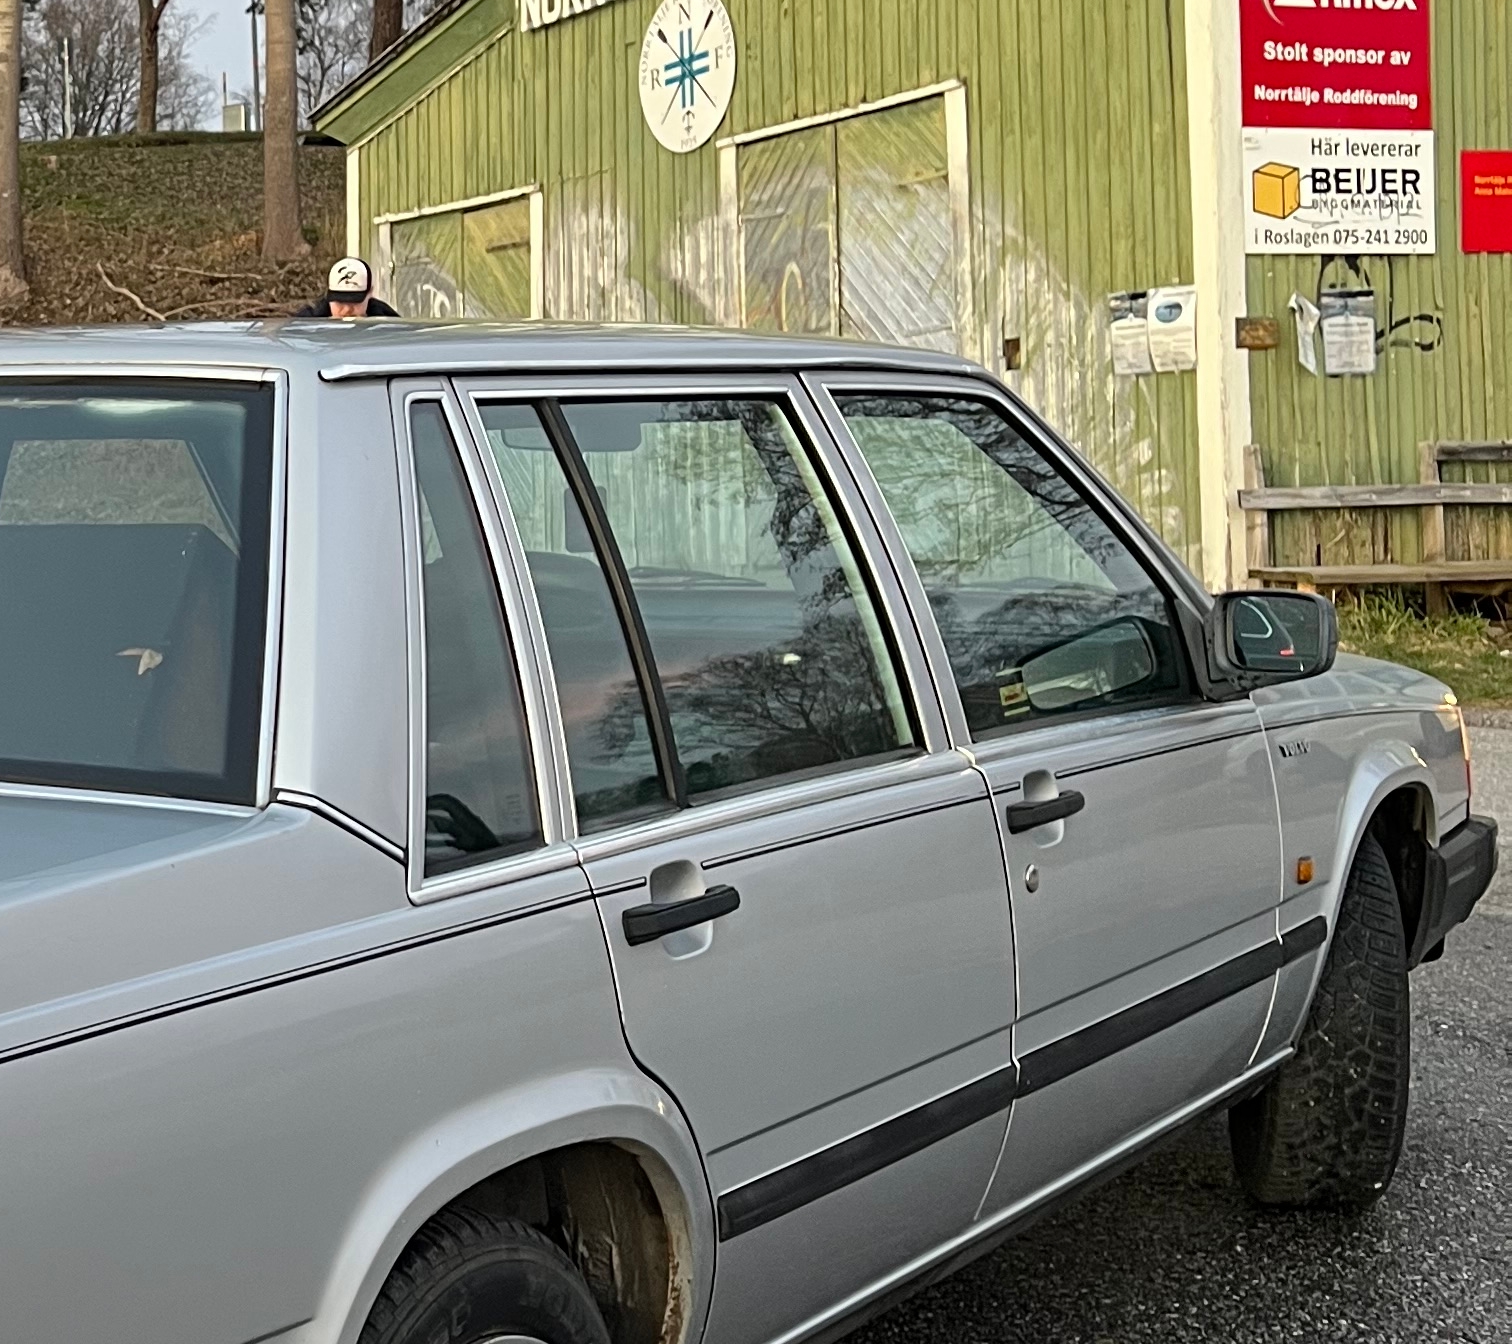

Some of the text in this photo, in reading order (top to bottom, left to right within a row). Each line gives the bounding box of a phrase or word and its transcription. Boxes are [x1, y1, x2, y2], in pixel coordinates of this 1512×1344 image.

[1263, 40, 1411, 67] Stolt sponsor av
[1253, 84, 1419, 110] Norrtälje Roddförening
[1311, 137, 1422, 157] Här levererar
[1311, 167, 1421, 196] BEIJER
[1264, 228, 1329, 248] Roslagen
[1333, 229, 1389, 245] 075-241
[1394, 229, 1428, 245] 2900
